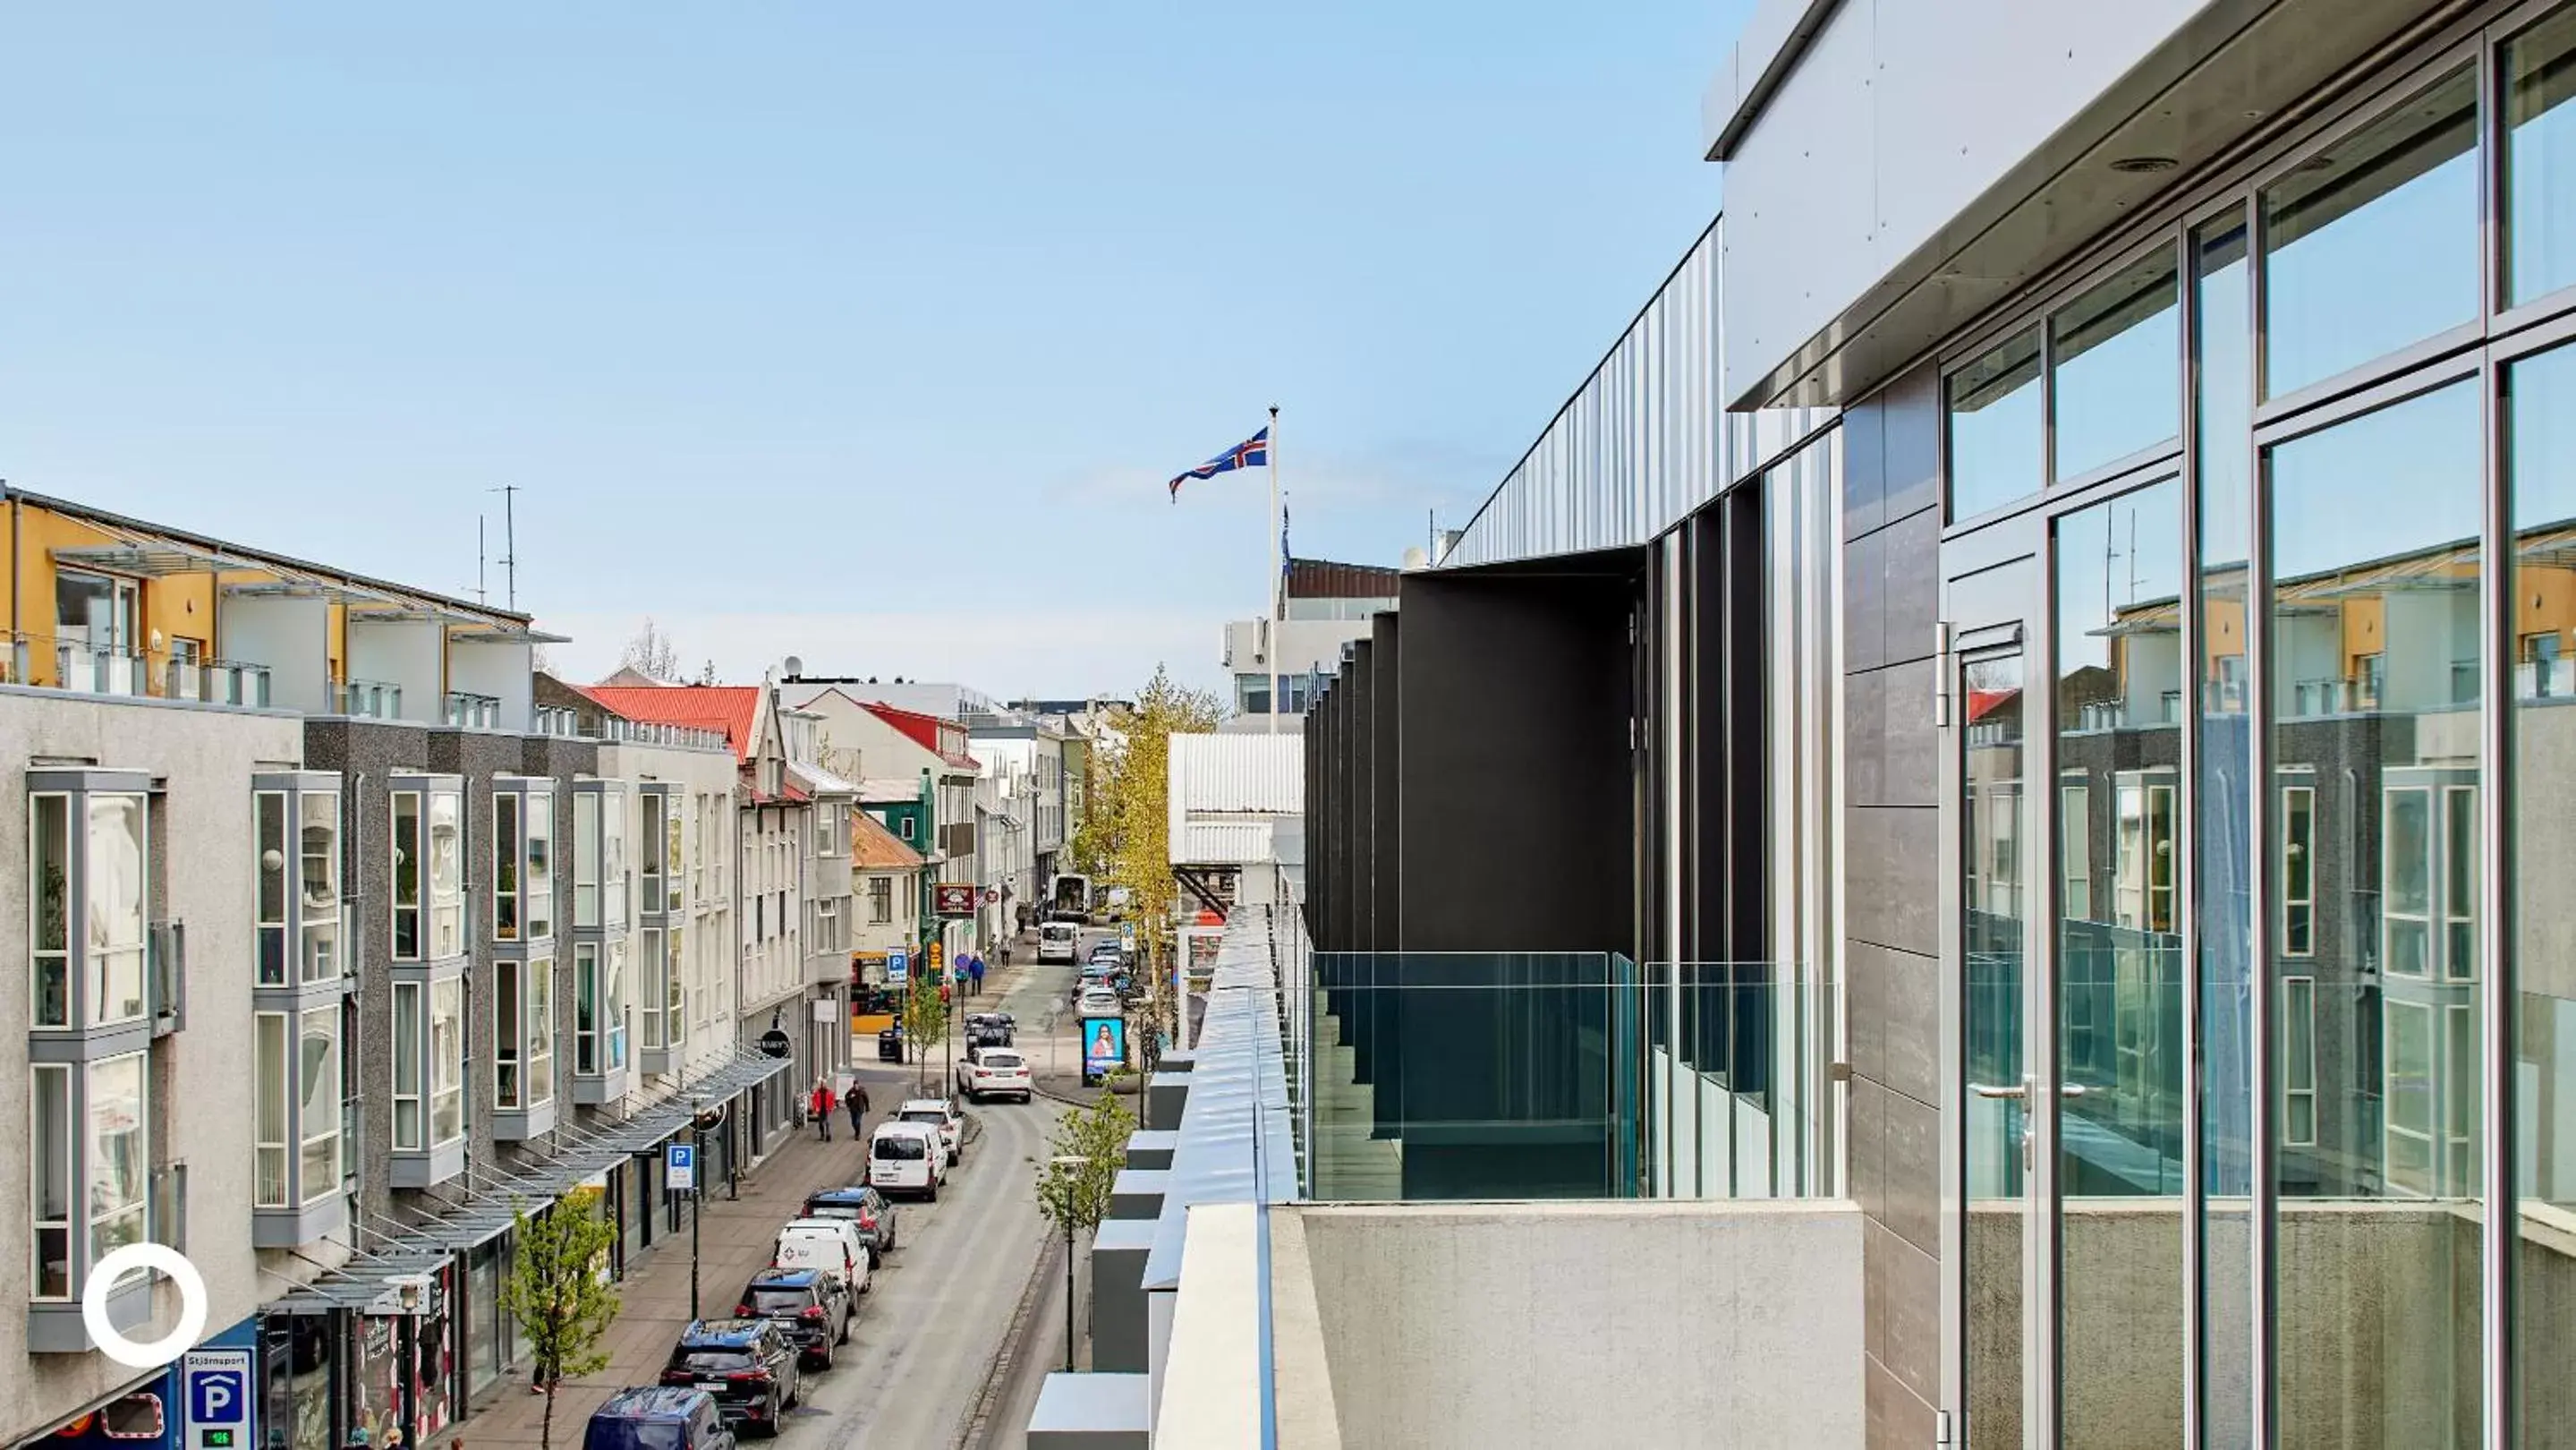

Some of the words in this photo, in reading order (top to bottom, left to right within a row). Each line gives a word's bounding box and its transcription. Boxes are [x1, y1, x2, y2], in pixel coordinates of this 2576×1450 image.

[892, 957, 901, 968] P
[676, 1150, 686, 1164] P
[206, 1386, 231, 1419] P
